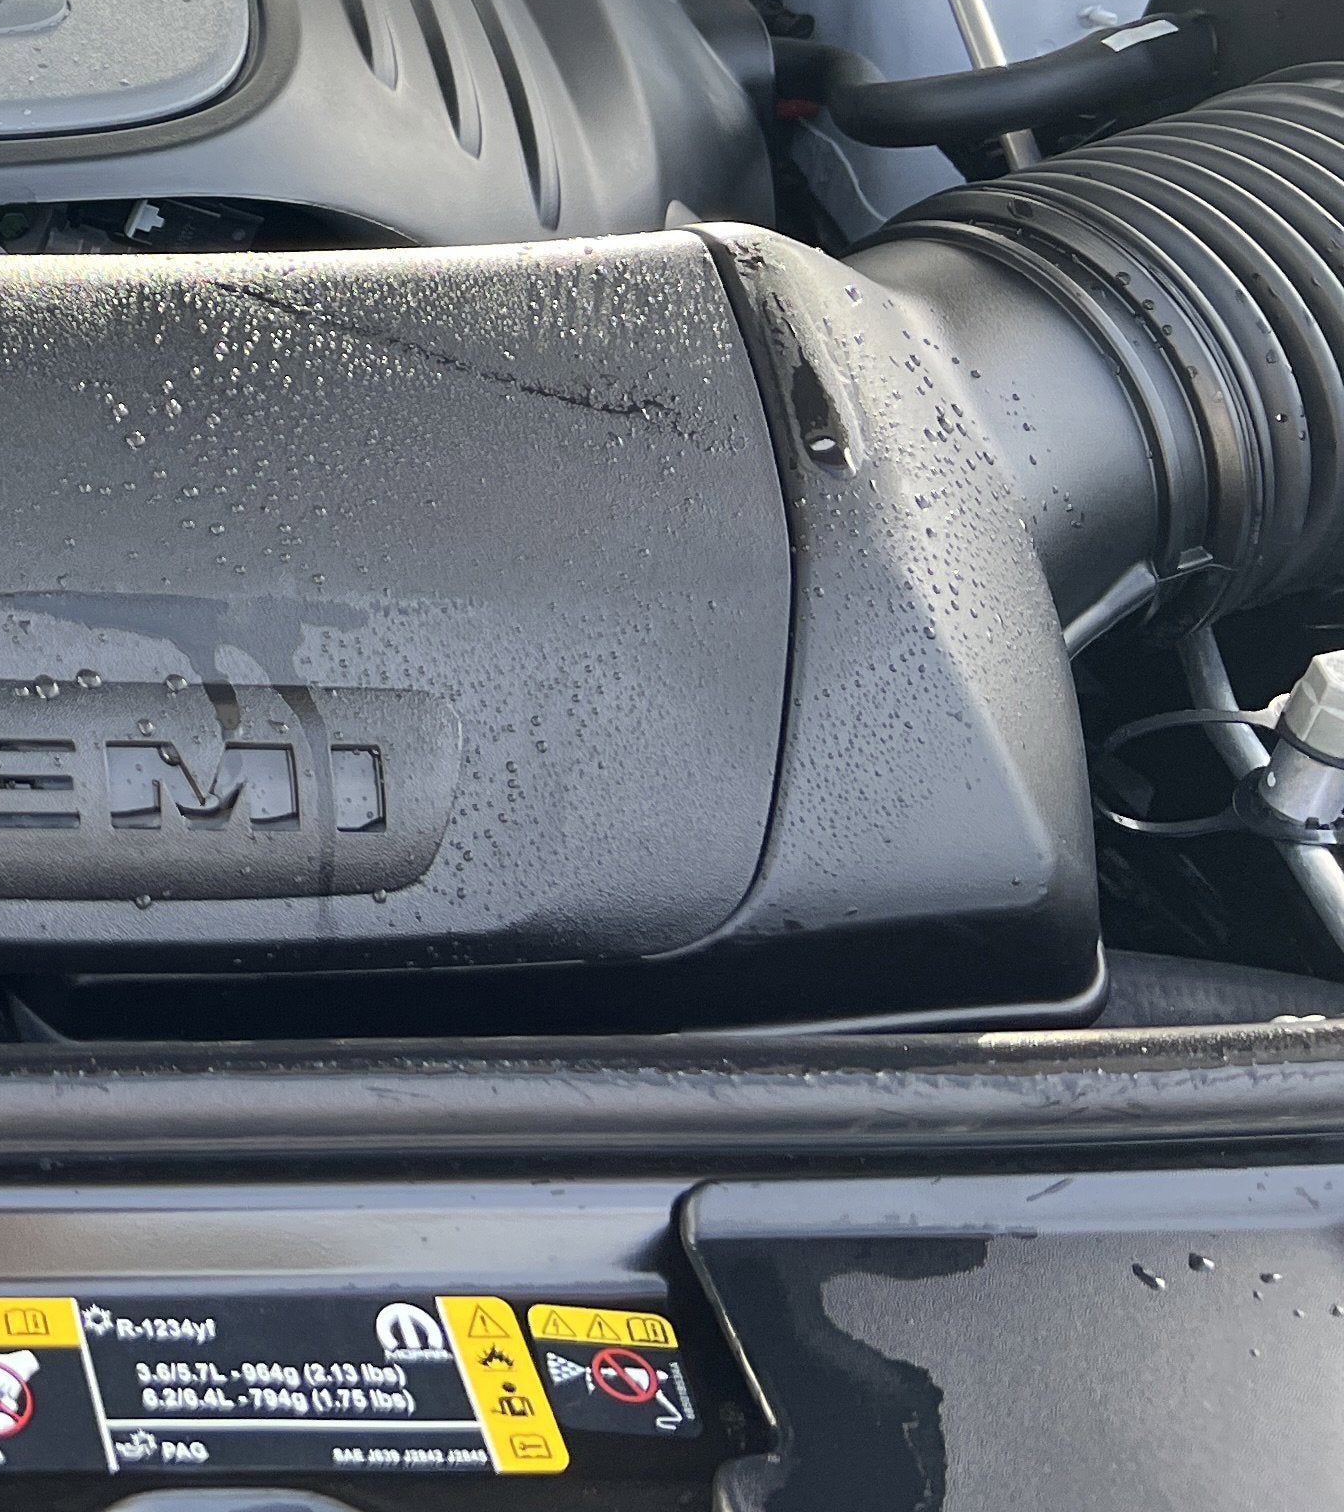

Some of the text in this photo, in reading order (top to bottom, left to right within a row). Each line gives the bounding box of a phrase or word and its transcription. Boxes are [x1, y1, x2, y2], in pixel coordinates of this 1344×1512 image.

[116, 1317, 217, 1345] R-1234yf
[135, 1362, 229, 1386] 3.6/5.7L
[303, 1362, 360, 1388] (2.13
[360, 1362, 408, 1389] lbs)
[141, 1387, 236, 1412] 6.2/6.4L
[248, 1387, 309, 1416] 794g
[311, 1388, 369, 1414] (1.75
[368, 1388, 417, 1417] lbs)
[161, 1441, 210, 1464] PAG
